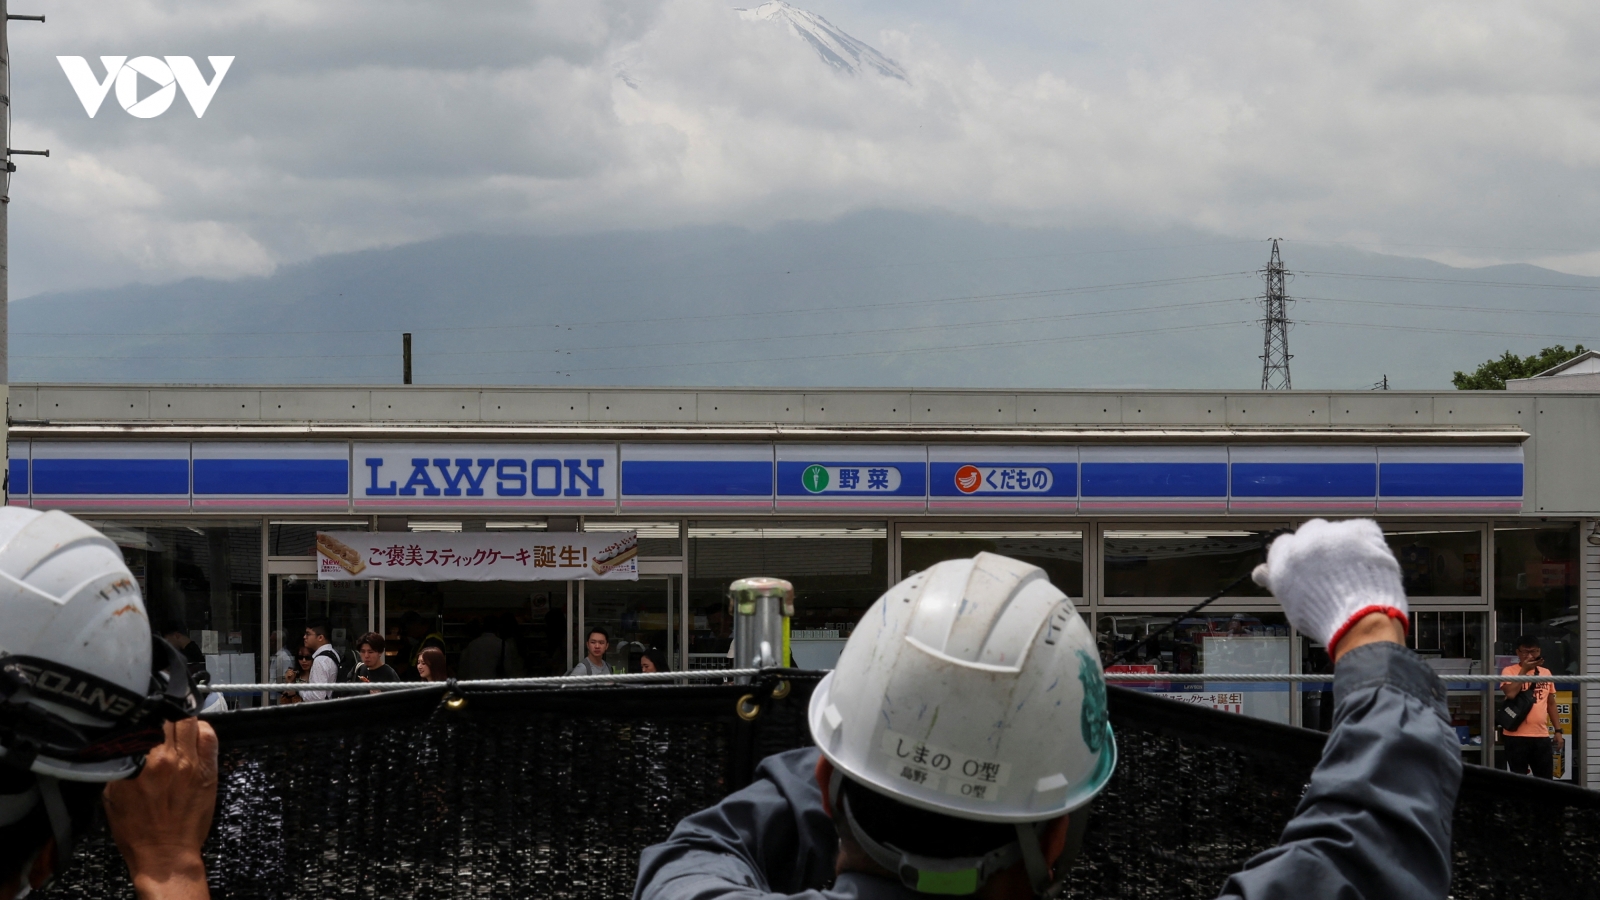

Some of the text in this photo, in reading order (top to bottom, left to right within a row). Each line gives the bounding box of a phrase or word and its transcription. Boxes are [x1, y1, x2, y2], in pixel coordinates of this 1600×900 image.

[365, 457, 604, 497] LAWSON
[838, 468, 889, 490] 野菜
[985, 469, 1048, 490] くだもの
[896, 738, 1001, 783] しまの O型
[960, 783, 987, 800] O型
